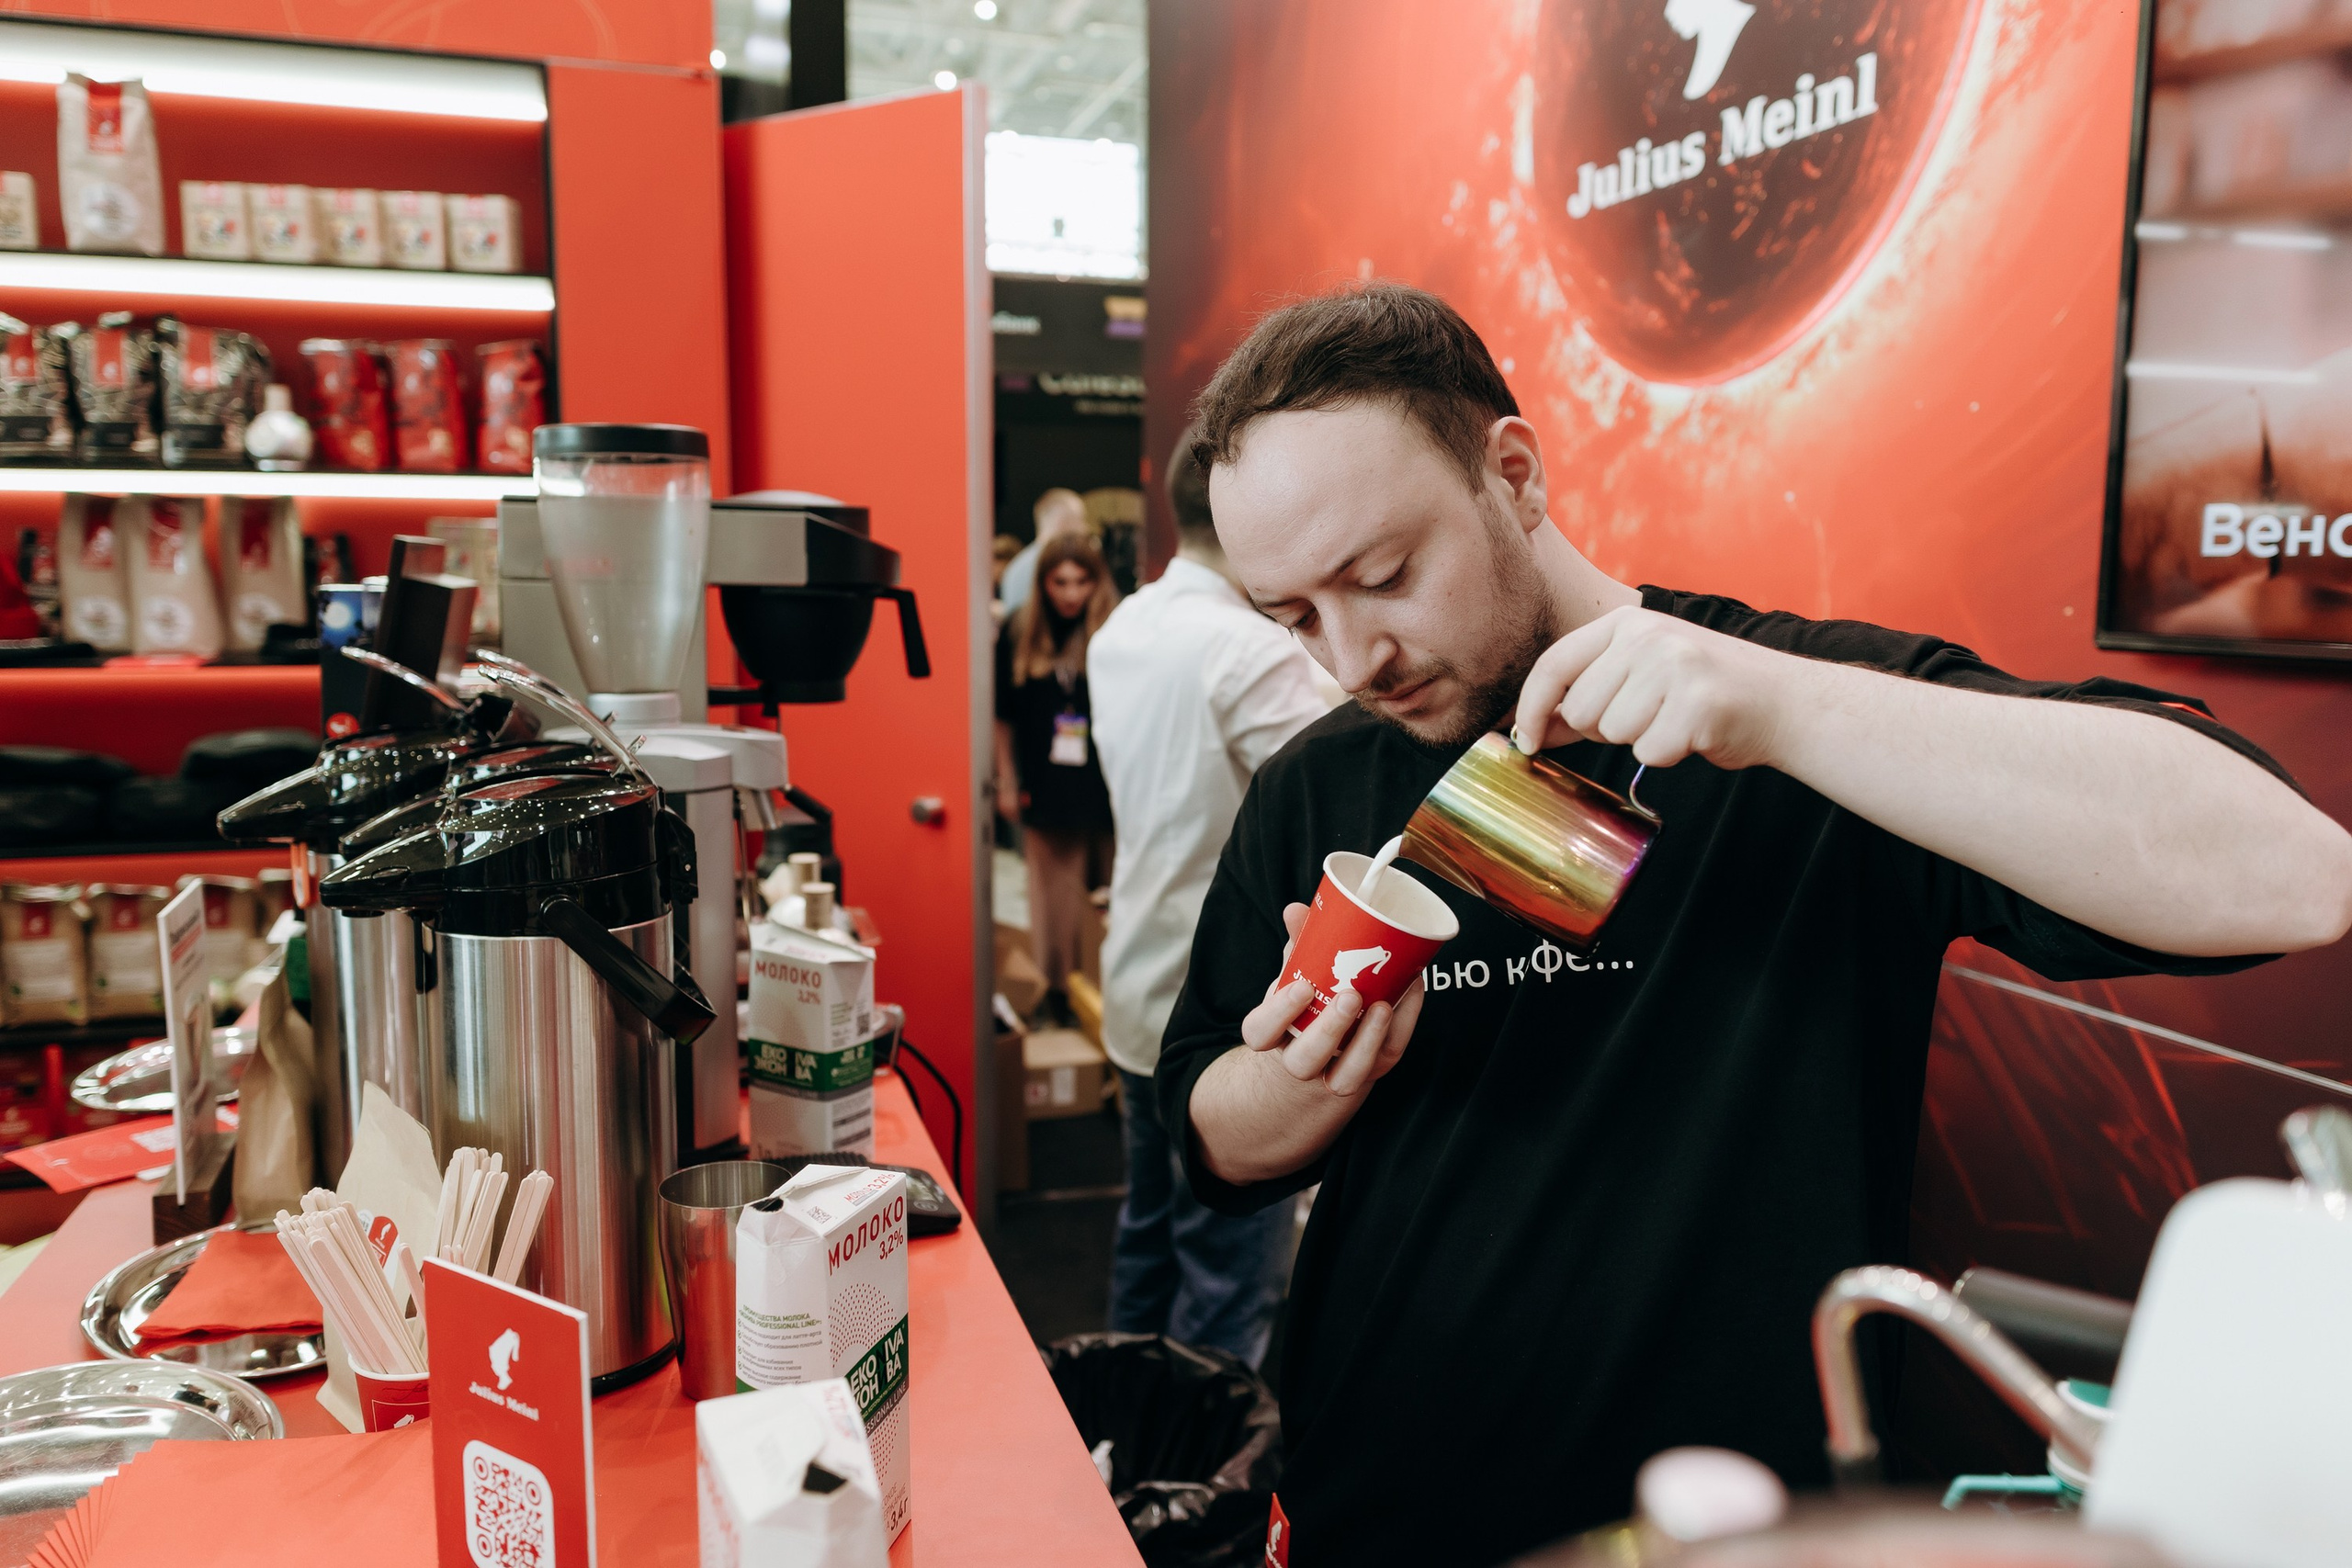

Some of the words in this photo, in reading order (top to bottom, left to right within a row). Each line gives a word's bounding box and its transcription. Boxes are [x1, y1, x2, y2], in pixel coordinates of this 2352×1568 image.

[1566, 130, 1706, 220] Julius
[1717, 51, 1880, 166] Meinl
[755, 961, 821, 989] МОЛОКО
[828, 1195, 904, 1277] МОЛОКО
[879, 1227, 904, 1260] 3,2%
[850, 1354, 876, 1394] EKO
[887, 1352, 902, 1383] ВА
